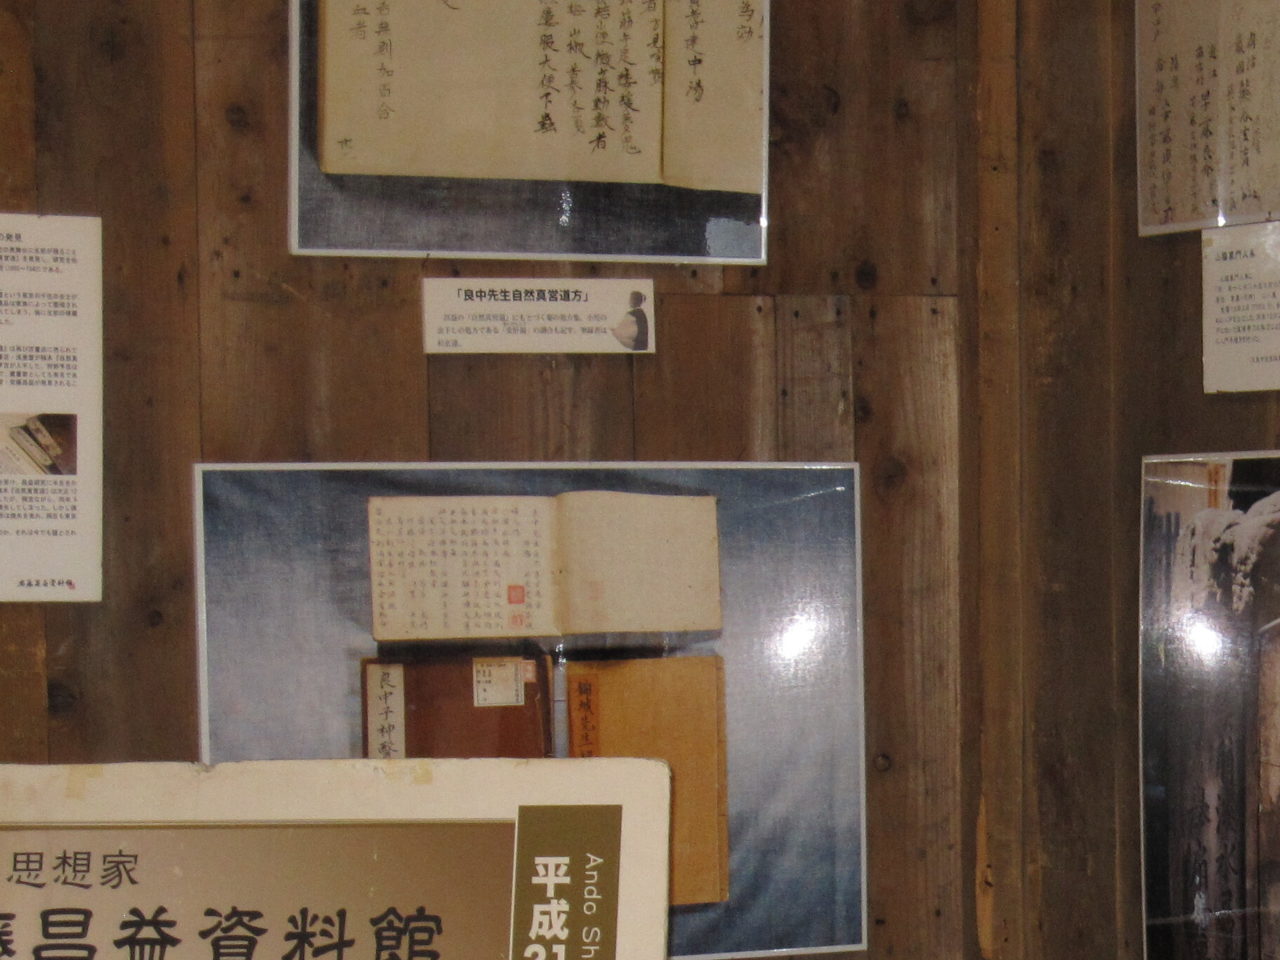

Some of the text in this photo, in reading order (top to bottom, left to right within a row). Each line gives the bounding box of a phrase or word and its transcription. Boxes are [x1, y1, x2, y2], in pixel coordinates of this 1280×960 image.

[7, 849, 139, 889] 思想家
[582, 852, 605, 916] Ando
